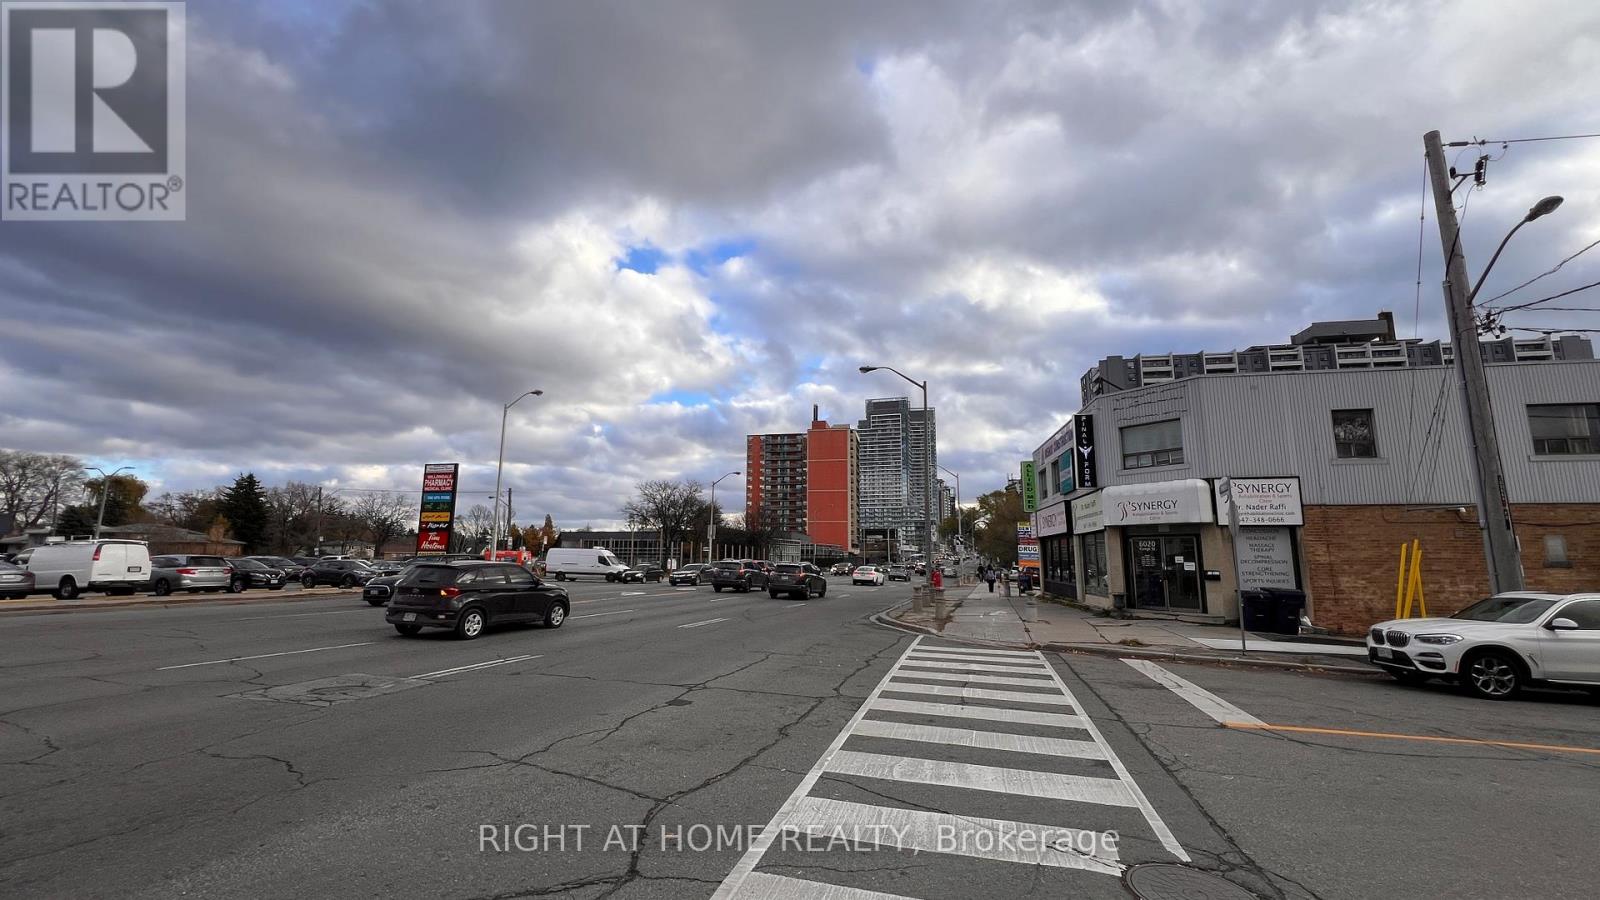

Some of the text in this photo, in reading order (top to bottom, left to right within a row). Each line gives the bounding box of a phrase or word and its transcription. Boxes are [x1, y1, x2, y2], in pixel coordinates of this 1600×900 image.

[1084, 461, 1092, 487] FORM
[425, 479, 453, 487] PHARMACY
[1238, 484, 1292, 494] SYNERGY
[1131, 499, 1178, 512] SYNERGY
[421, 541, 445, 550] Hortons
